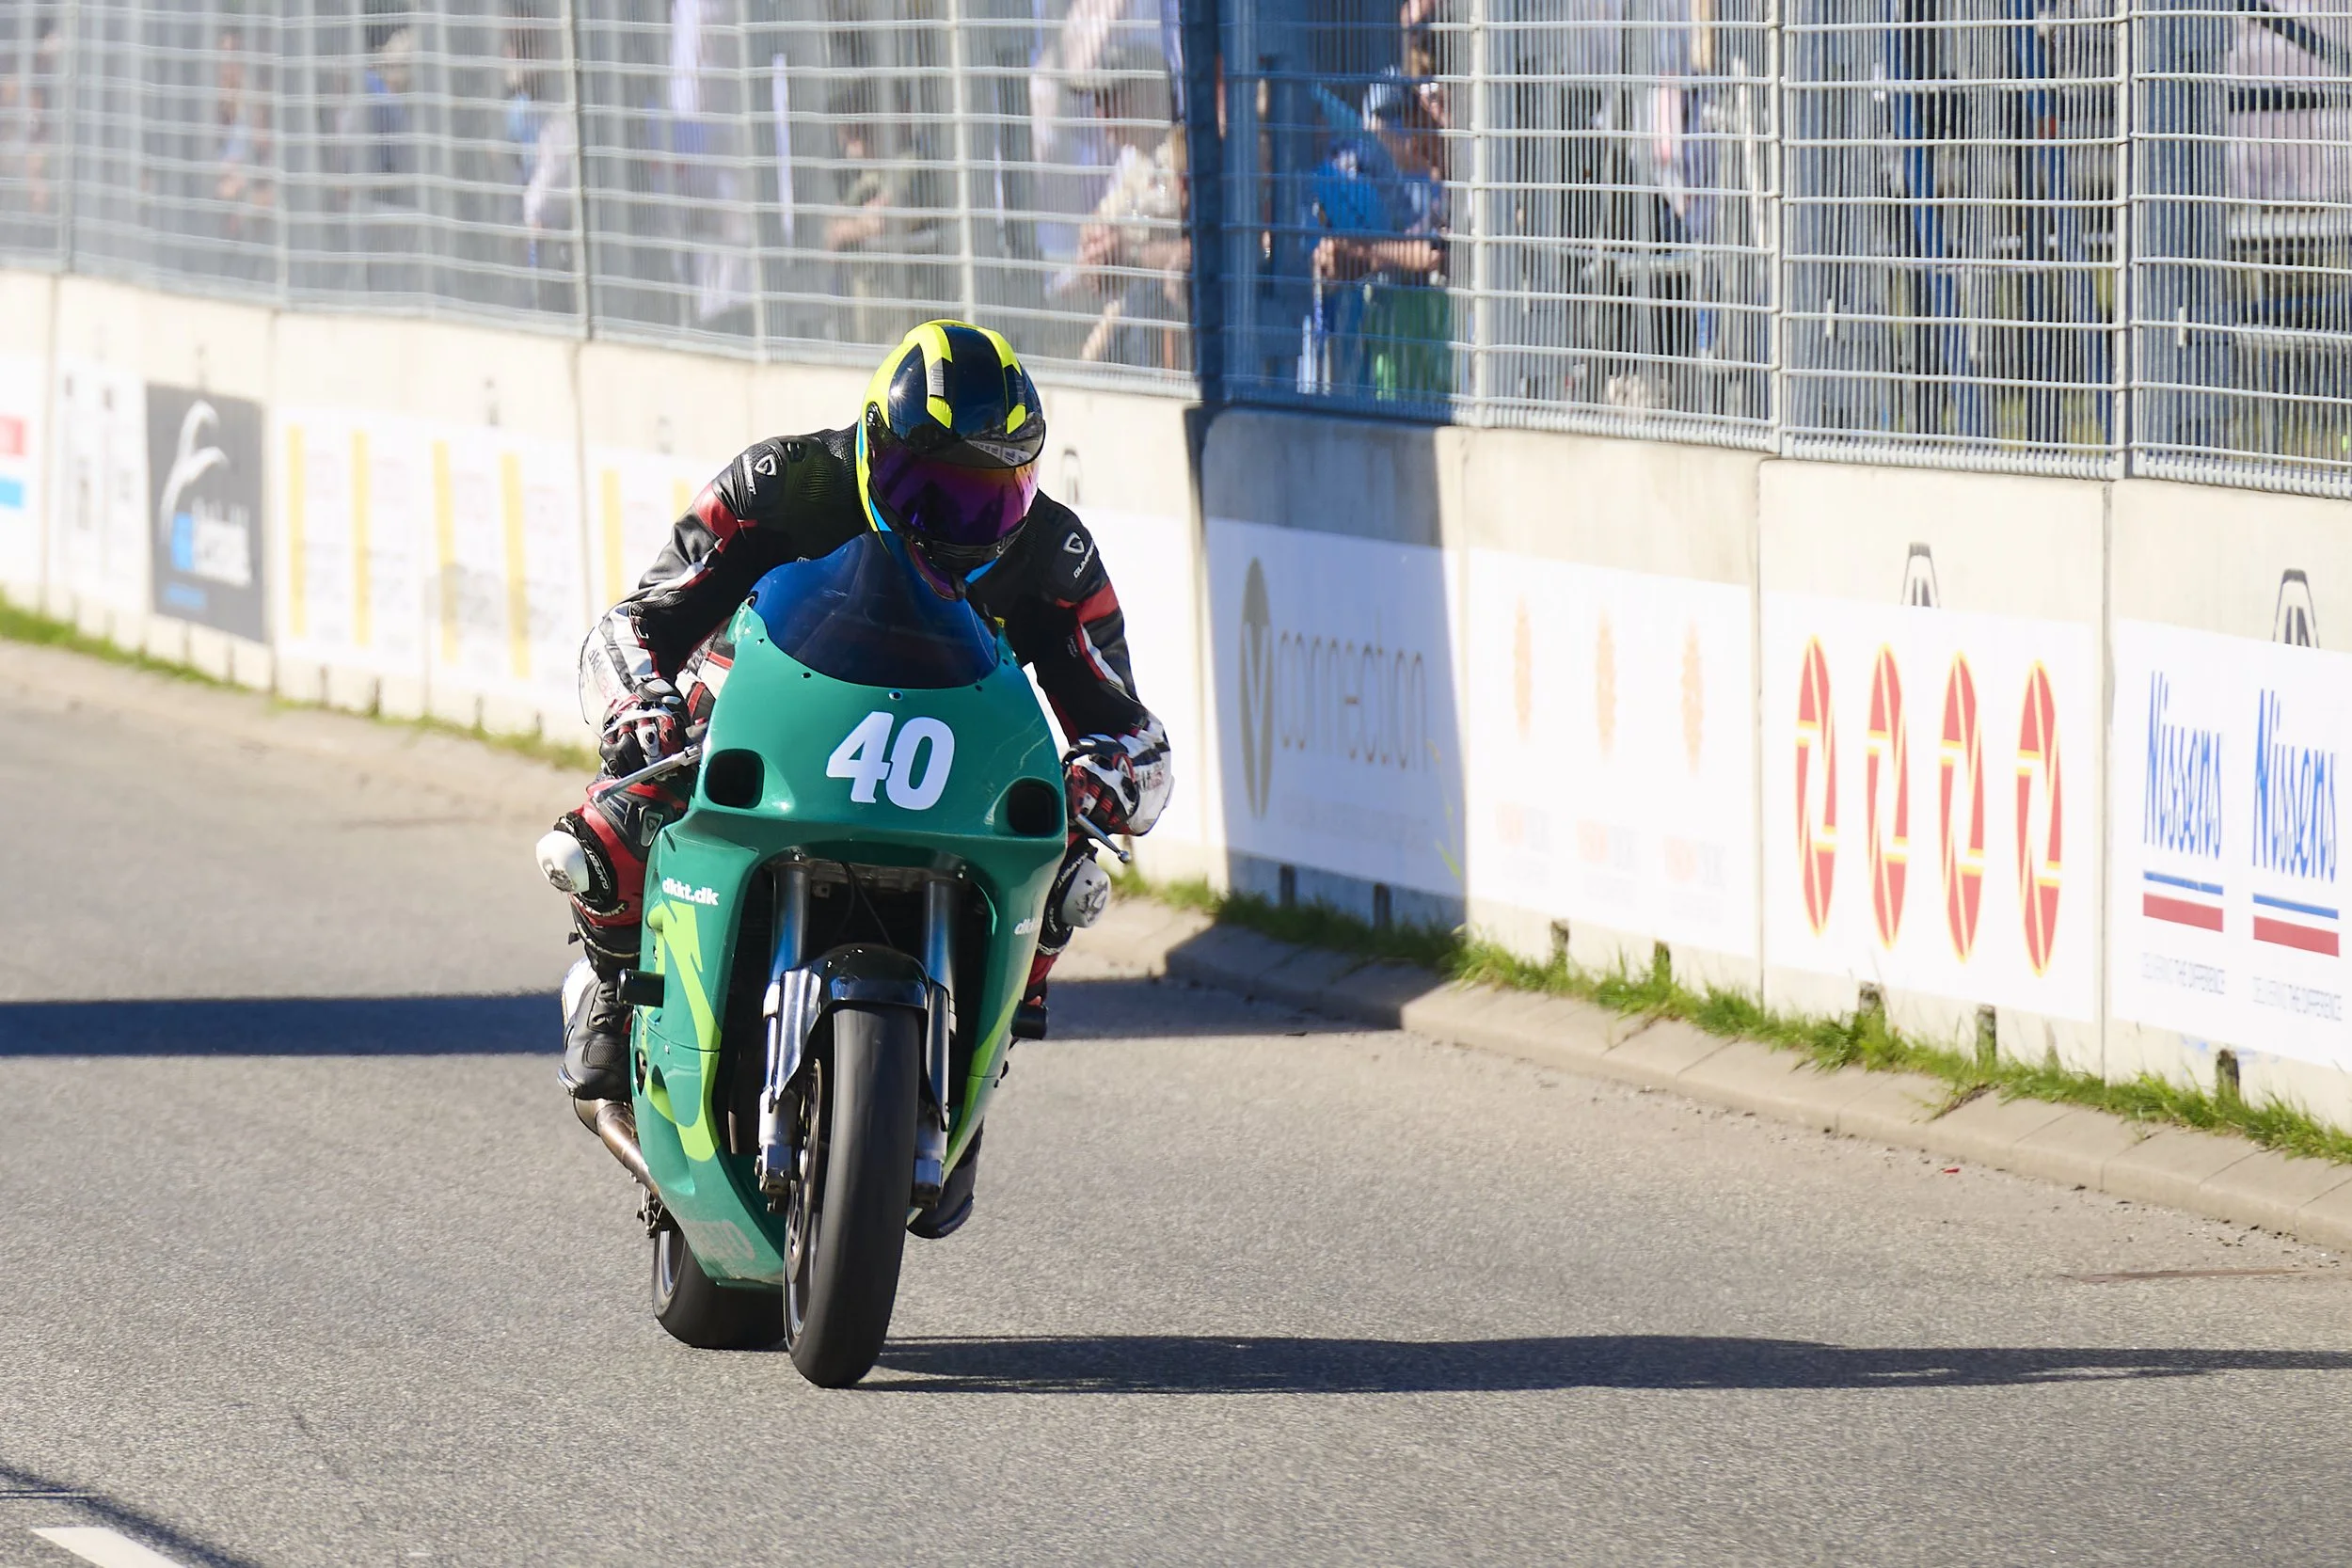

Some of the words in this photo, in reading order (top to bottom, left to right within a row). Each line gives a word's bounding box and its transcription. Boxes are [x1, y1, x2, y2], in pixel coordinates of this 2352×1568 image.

[826, 711, 956, 811] 40
[2143, 670, 2222, 861] Nissens
[2252, 688, 2337, 884] Nissens
